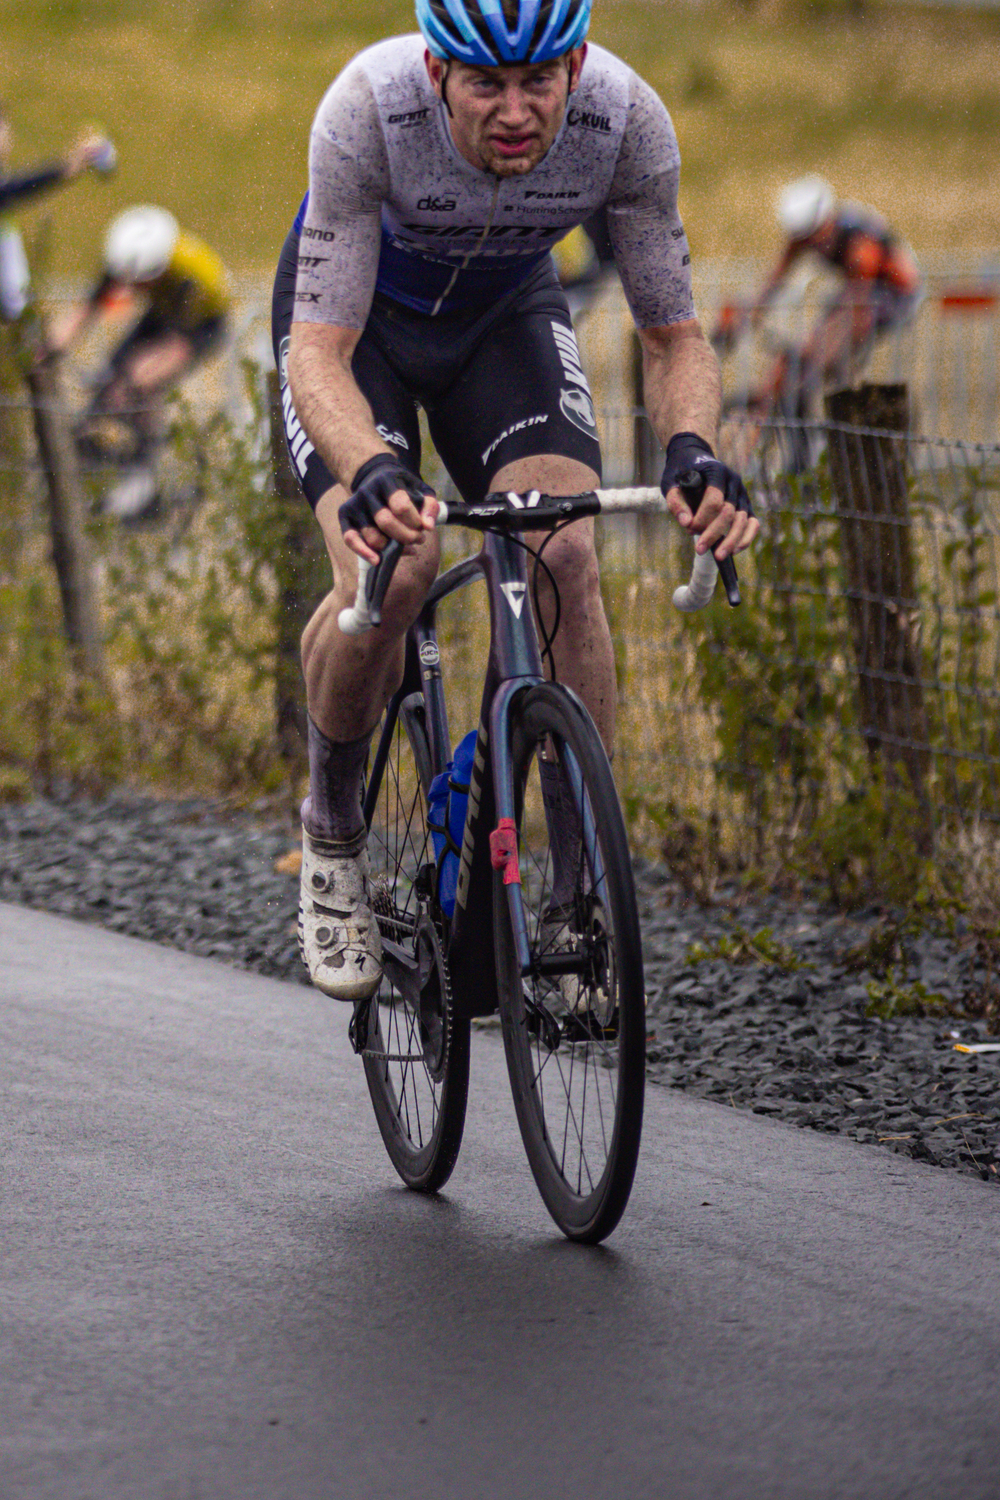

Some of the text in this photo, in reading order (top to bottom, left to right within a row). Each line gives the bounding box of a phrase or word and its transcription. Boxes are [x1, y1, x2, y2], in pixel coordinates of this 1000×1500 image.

[388, 107, 431, 124] GIANT
[416, 194, 457, 212] d&a
[537, 190, 581, 200] DAIKIN
[401, 224, 574, 238] GIANT
[491, 414, 549, 452] DAIKIN
